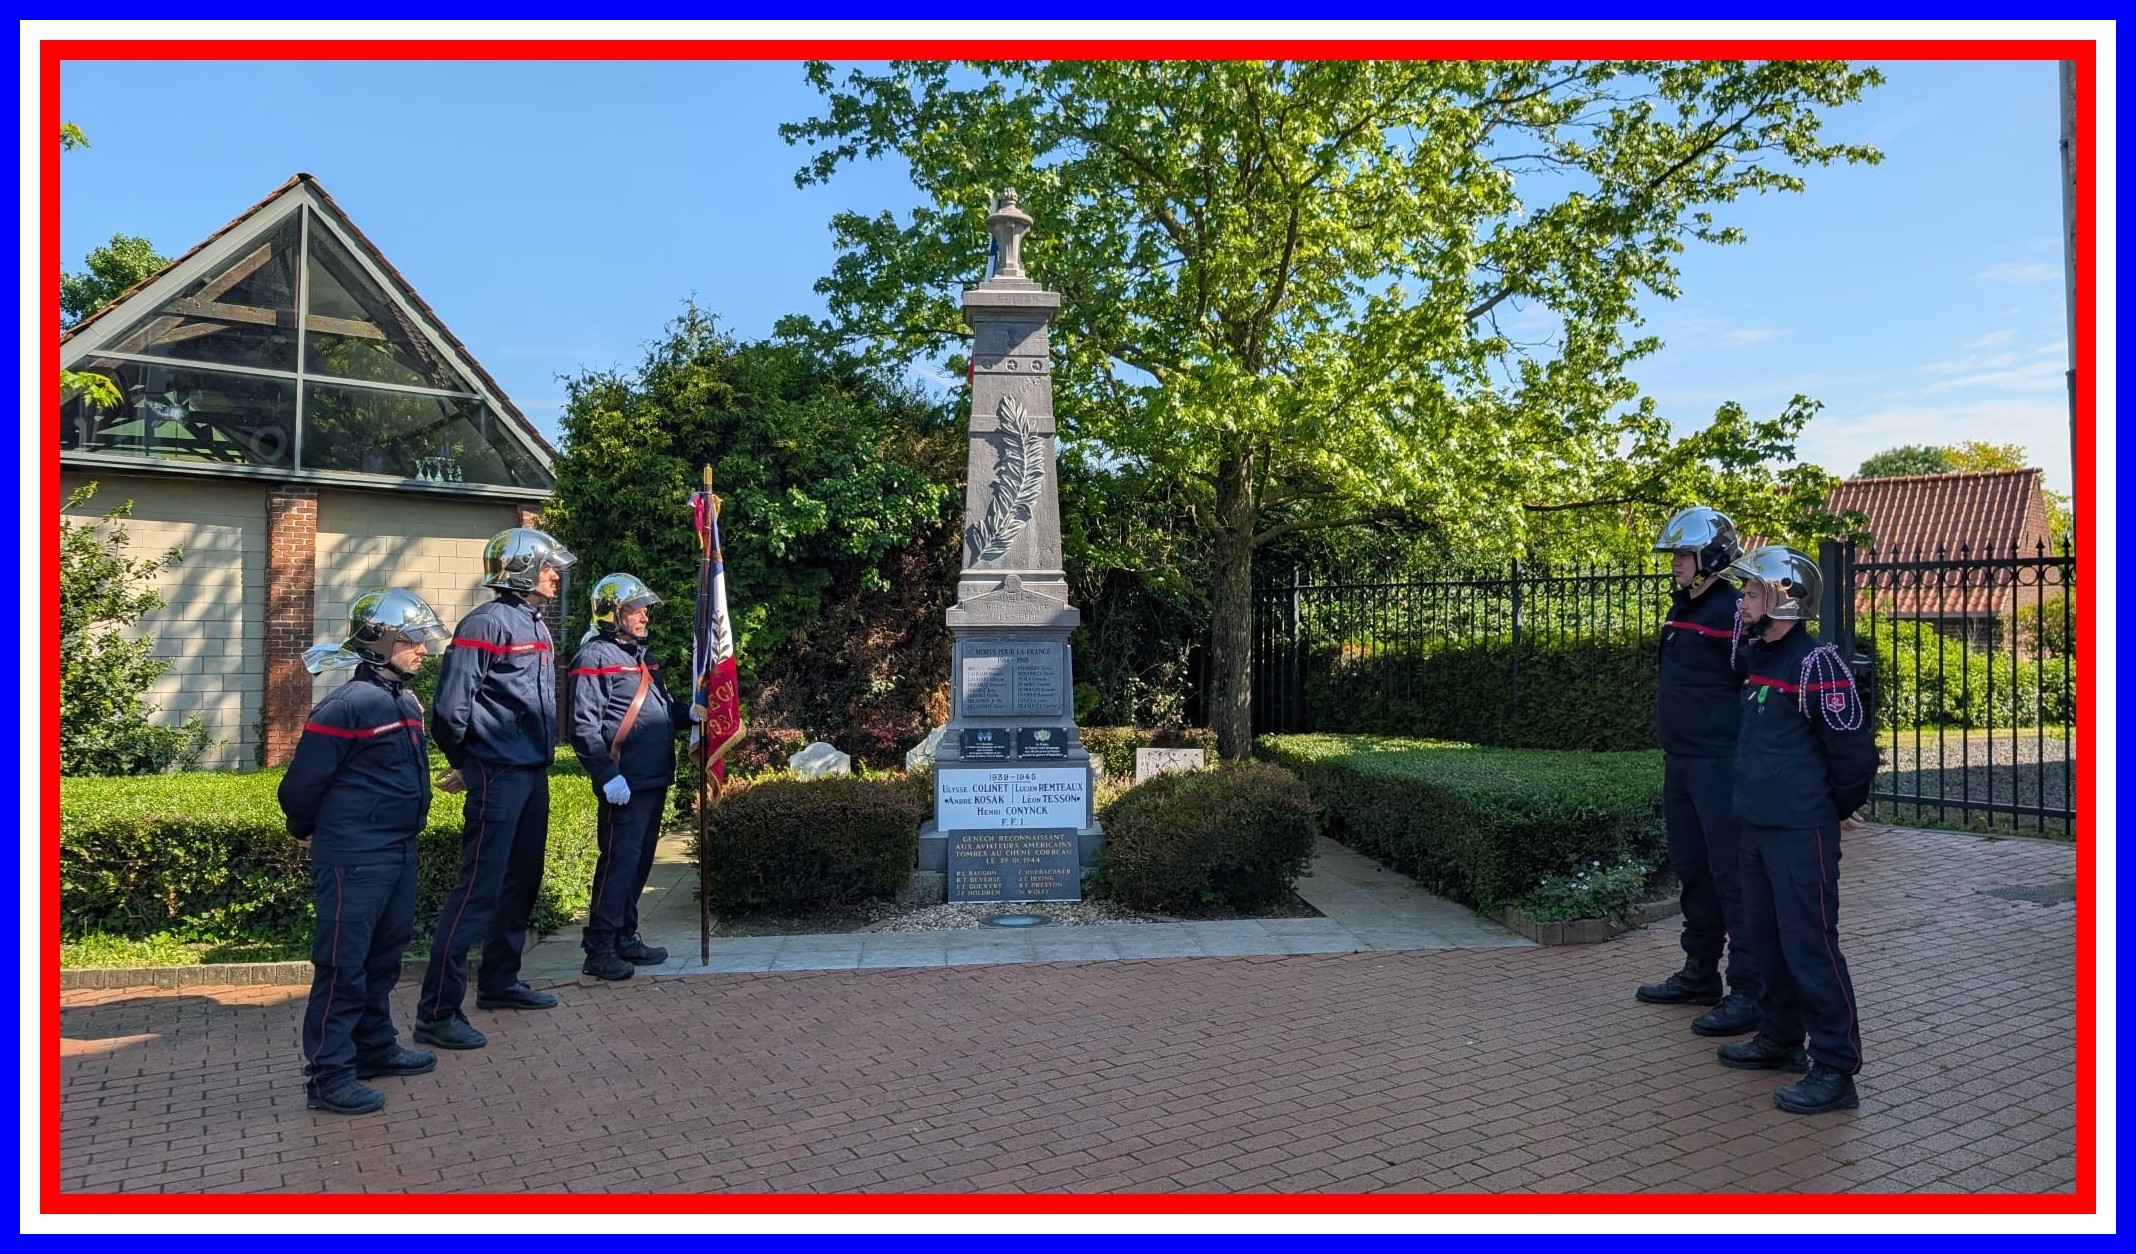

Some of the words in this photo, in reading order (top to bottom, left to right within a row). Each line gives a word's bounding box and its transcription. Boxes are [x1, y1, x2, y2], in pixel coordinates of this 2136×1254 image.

[972, 784, 1009, 792] COLINET
[1038, 783, 1083, 791] REMTEAUX
[974, 796, 1004, 804] KOSAK
[1042, 795, 1077, 803] TESSON
[977, 807, 1001, 815] HENRI
[1005, 806, 1048, 815] CONYNCK
[998, 834, 1065, 842] RECONNAISSANT
